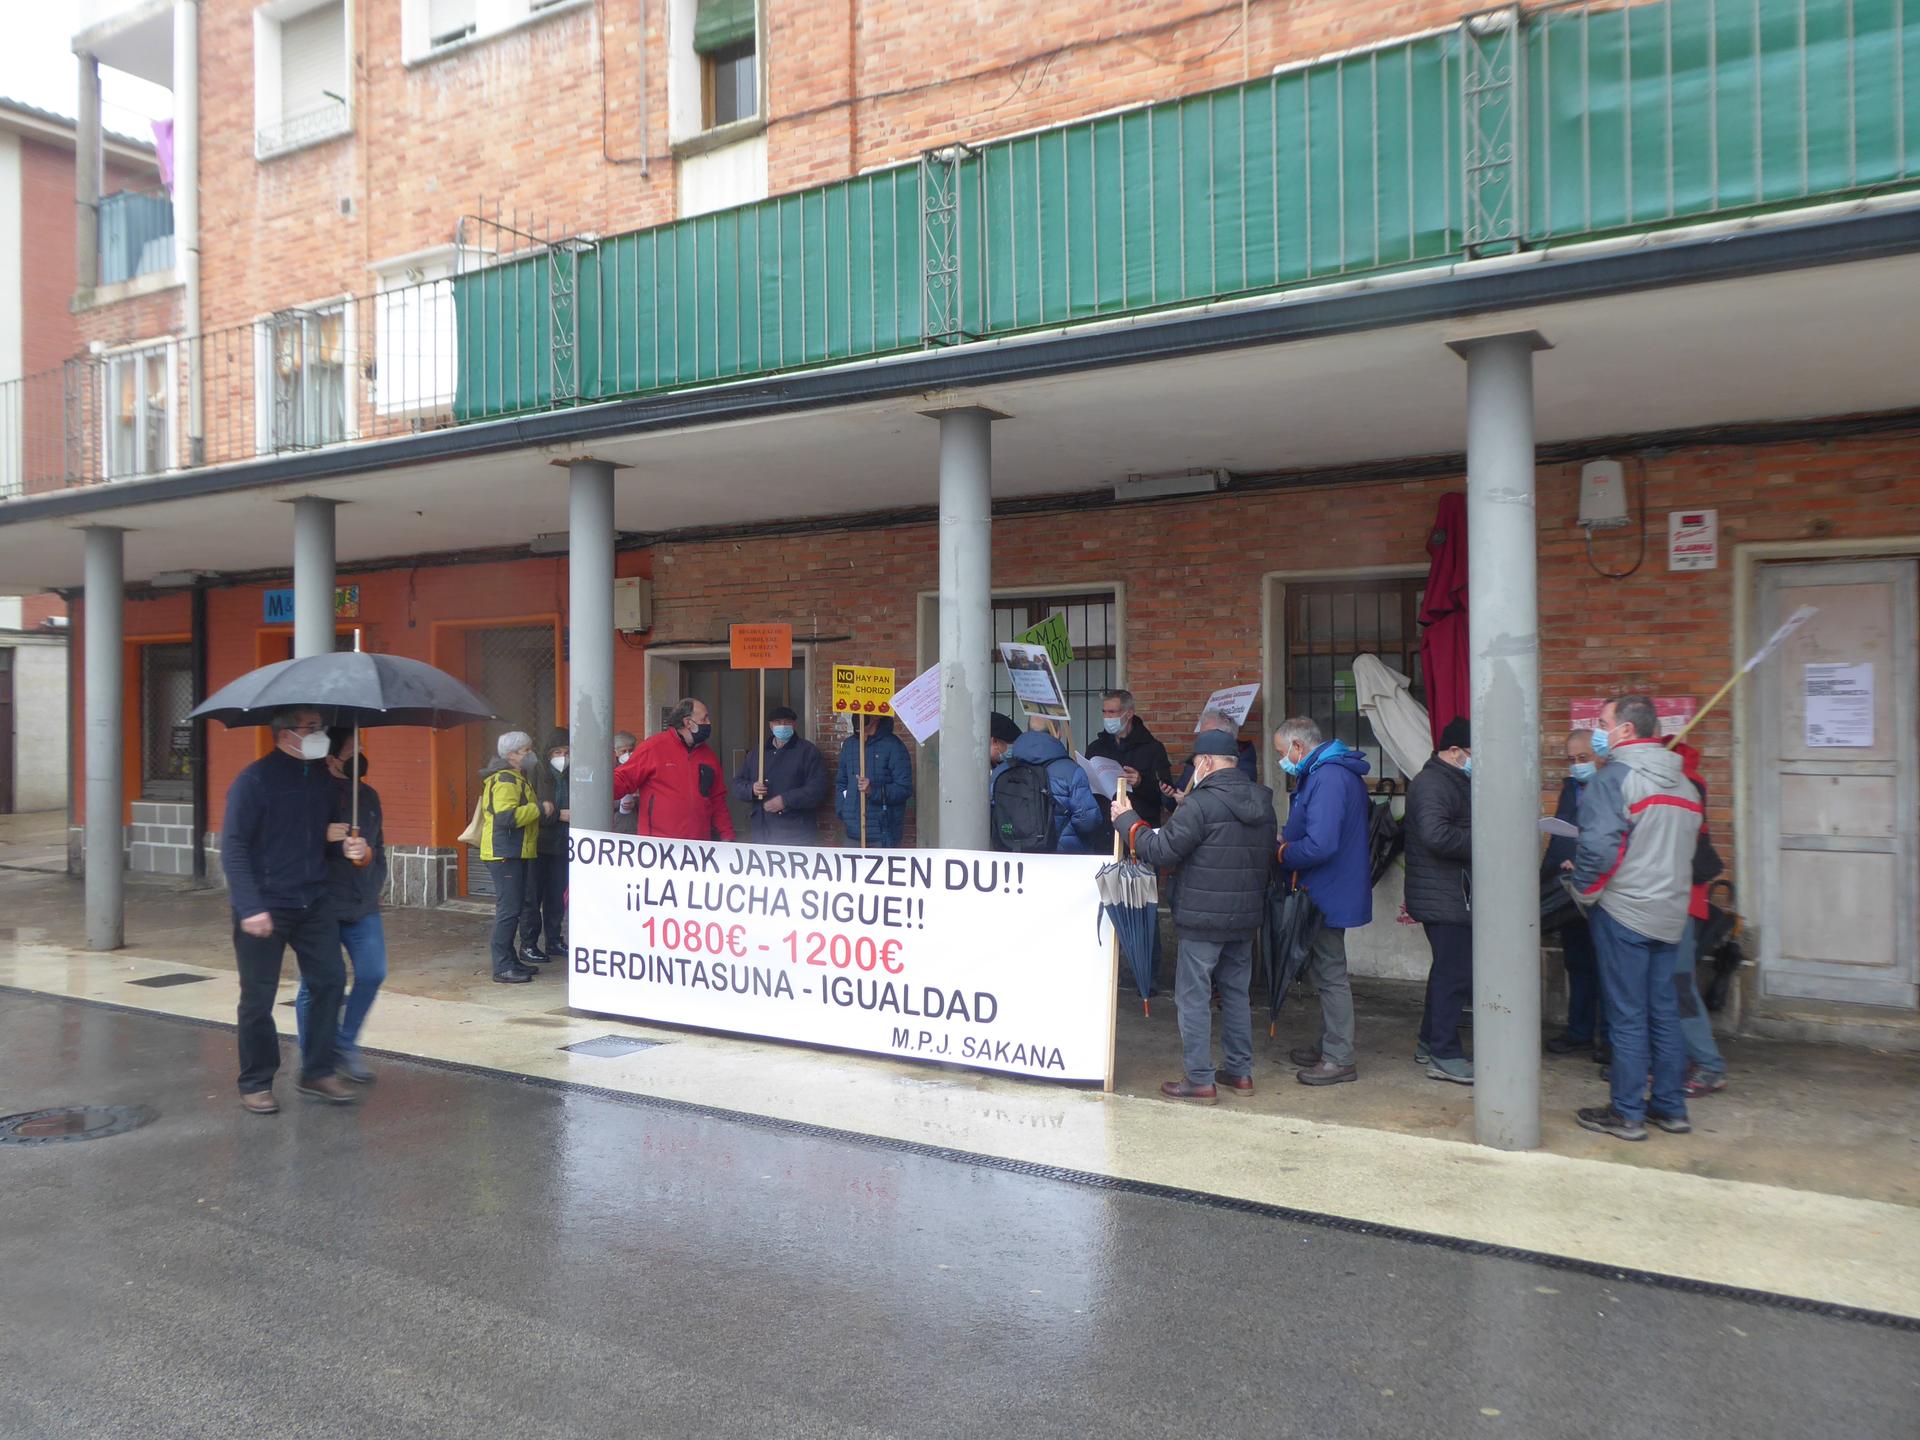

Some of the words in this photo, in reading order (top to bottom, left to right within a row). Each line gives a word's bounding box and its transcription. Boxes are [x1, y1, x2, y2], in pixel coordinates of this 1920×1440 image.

[838, 671, 853, 681] NO
[873, 675, 890, 683] PAN
[856, 686, 890, 695] CHORIZO
[729, 848, 932, 889] JARRAITZEN
[945, 858, 1024, 894] DU!!
[687, 880, 790, 917] LUCHA
[801, 889, 924, 929] SIGUE!!
[642, 916, 747, 957] 1080€
[782, 930, 904, 974] 1200€
[575, 947, 794, 1000] BERDINTASUNA
[822, 974, 998, 1023] IGUALDAD
[892, 1027, 952, 1055] M.P.J.
[961, 1036, 1065, 1070] SAKANA
